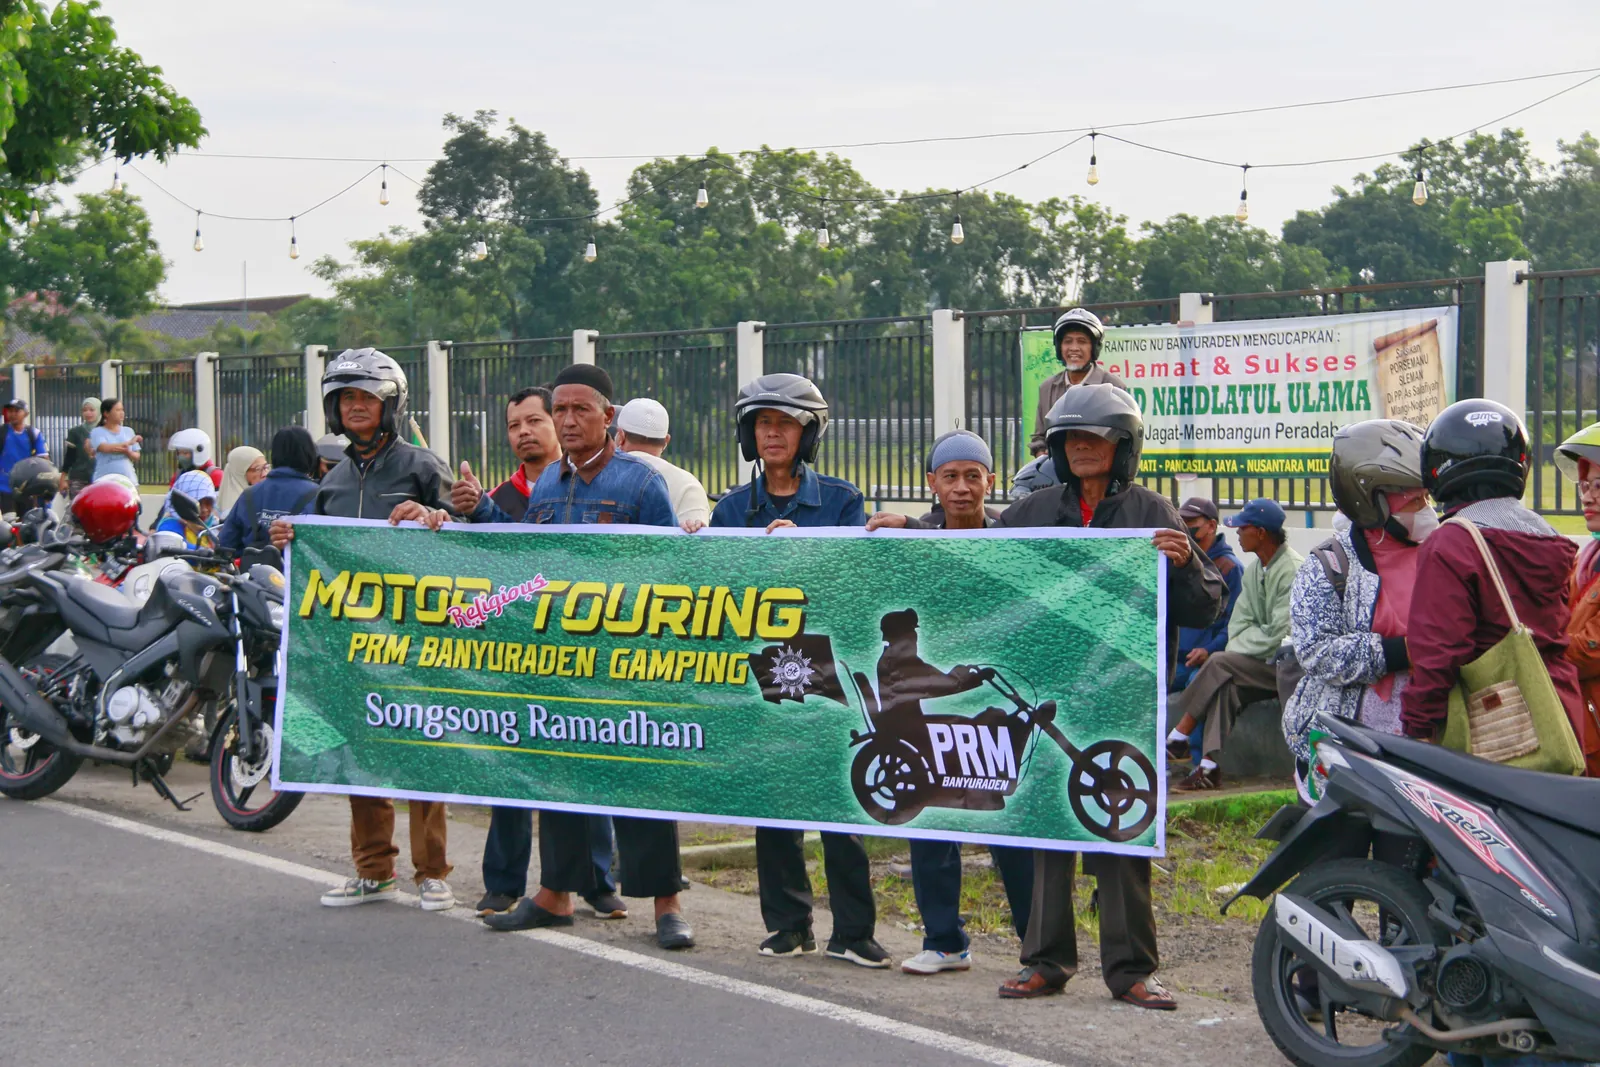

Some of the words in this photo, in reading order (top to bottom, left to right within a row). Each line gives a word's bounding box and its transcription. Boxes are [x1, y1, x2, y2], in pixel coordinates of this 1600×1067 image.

[1105, 339, 1147, 353] RANTING
[1150, 338, 1163, 351] NU
[1166, 334, 1240, 350] BANYURADEN
[1243, 329, 1334, 347] MENGUCAPKAN
[1097, 357, 1200, 379] elamat
[1213, 355, 1232, 376] &
[1244, 352, 1357, 375] Sukses
[1398, 370, 1424, 386] SLEMAN
[1127, 387, 1147, 416] D
[1152, 382, 1281, 416] NAHDLATUL
[1287, 379, 1372, 413] ULAMA
[1144, 423, 1271, 445] Jagat-Membangun
[1275, 420, 1344, 440] Peradab
[1164, 459, 1213, 473] PANCASILA
[1214, 459, 1239, 473] JAYA
[1246, 458, 1305, 473] NUSANTARA
[298, 568, 492, 625] MOTOR
[447, 573, 549, 628] Religious
[347, 632, 412, 666] PRM
[418, 636, 597, 678] BANYURADEN
[609, 648, 749, 684] GAMPING
[364, 692, 521, 744] Songsong
[526, 703, 704, 749] Ramadhan
[926, 723, 1017, 779] PRM
[942, 776, 1009, 791] BANYURADEN
